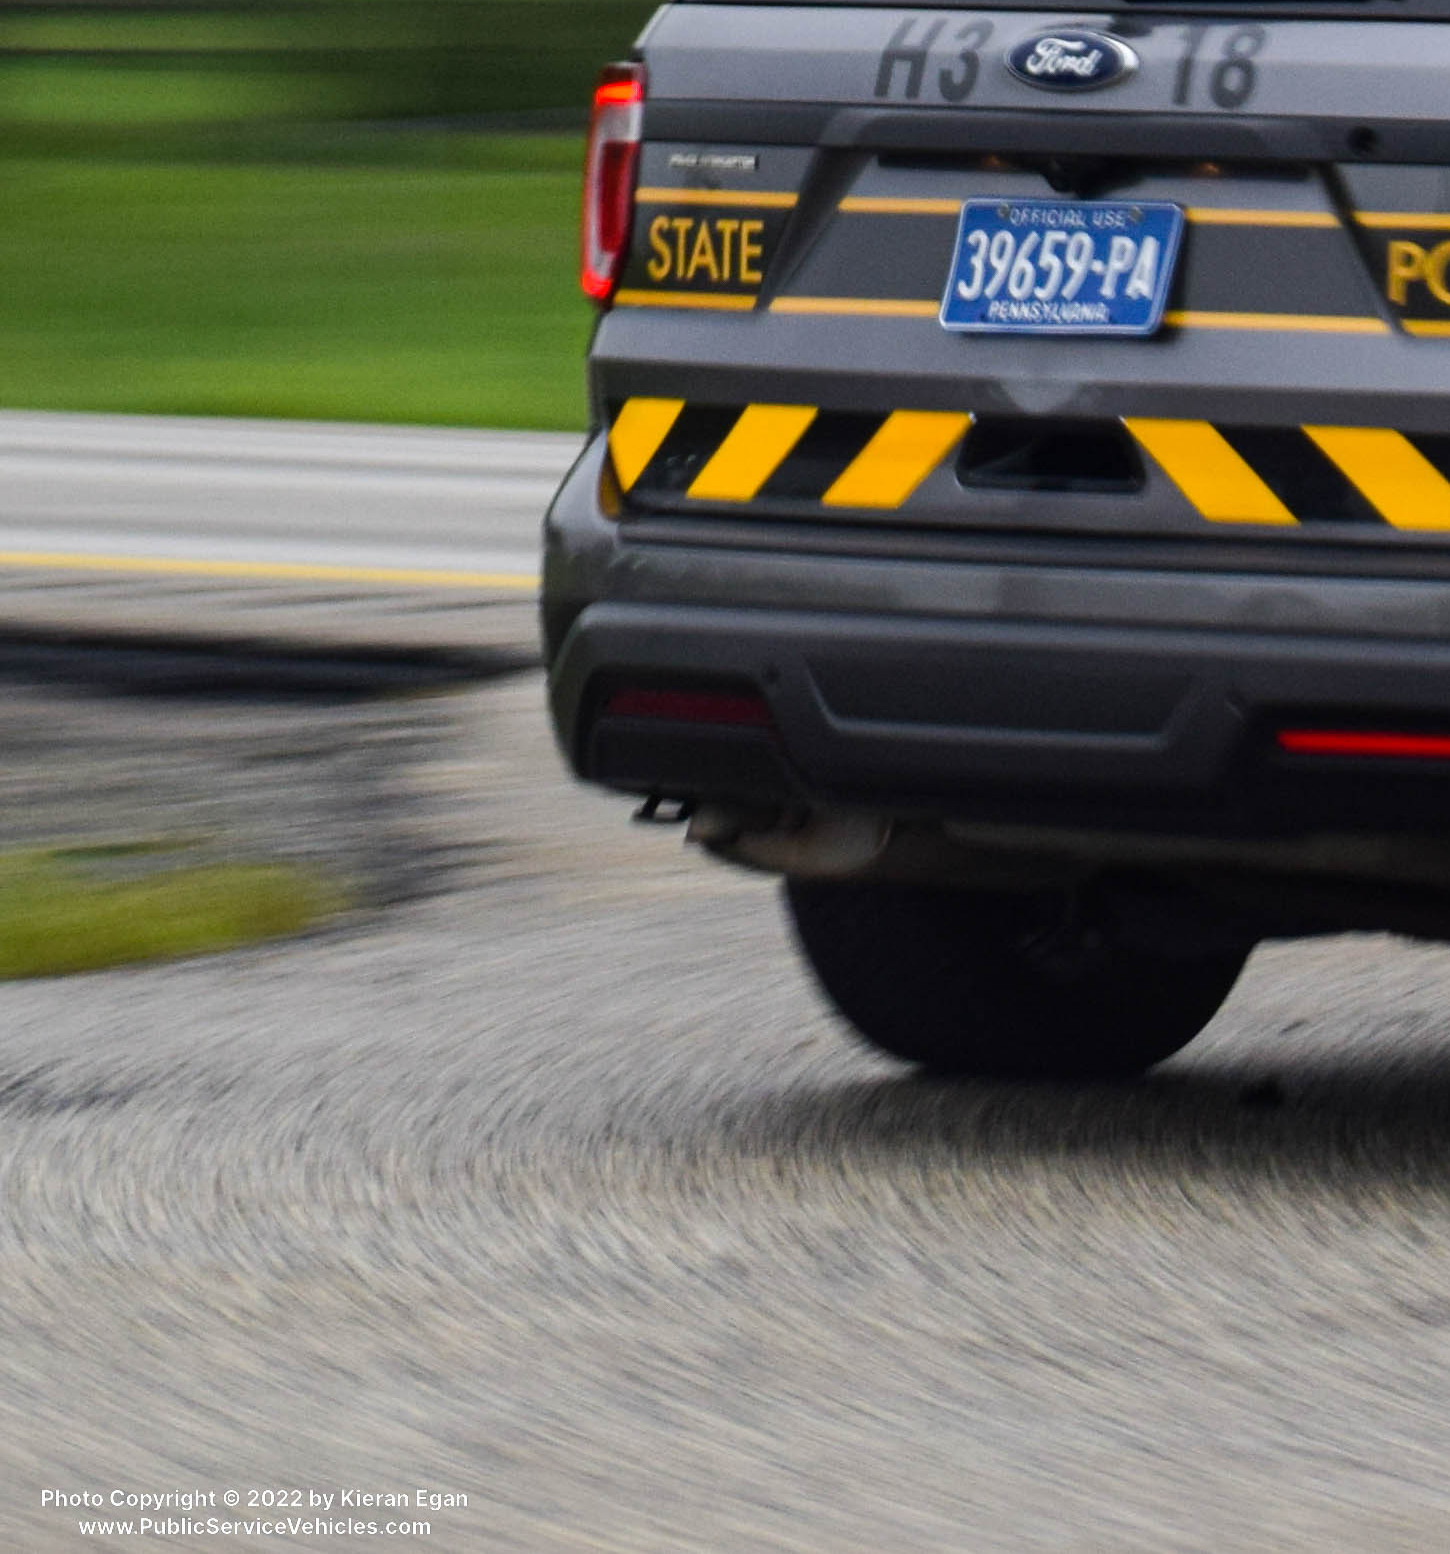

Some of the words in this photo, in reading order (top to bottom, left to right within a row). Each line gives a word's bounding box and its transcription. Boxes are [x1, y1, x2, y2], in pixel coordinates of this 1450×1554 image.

[873, 17, 995, 103] H3
[1172, 23, 1266, 109] 18
[1026, 37, 1101, 77] Ford
[1010, 206, 1088, 228] OFFICIAL
[1092, 210, 1128, 228] USE
[647, 215, 764, 283] STATE
[957, 228, 1161, 303] 39659-PA
[987, 299, 1110, 323] PENNSYLVANIA
